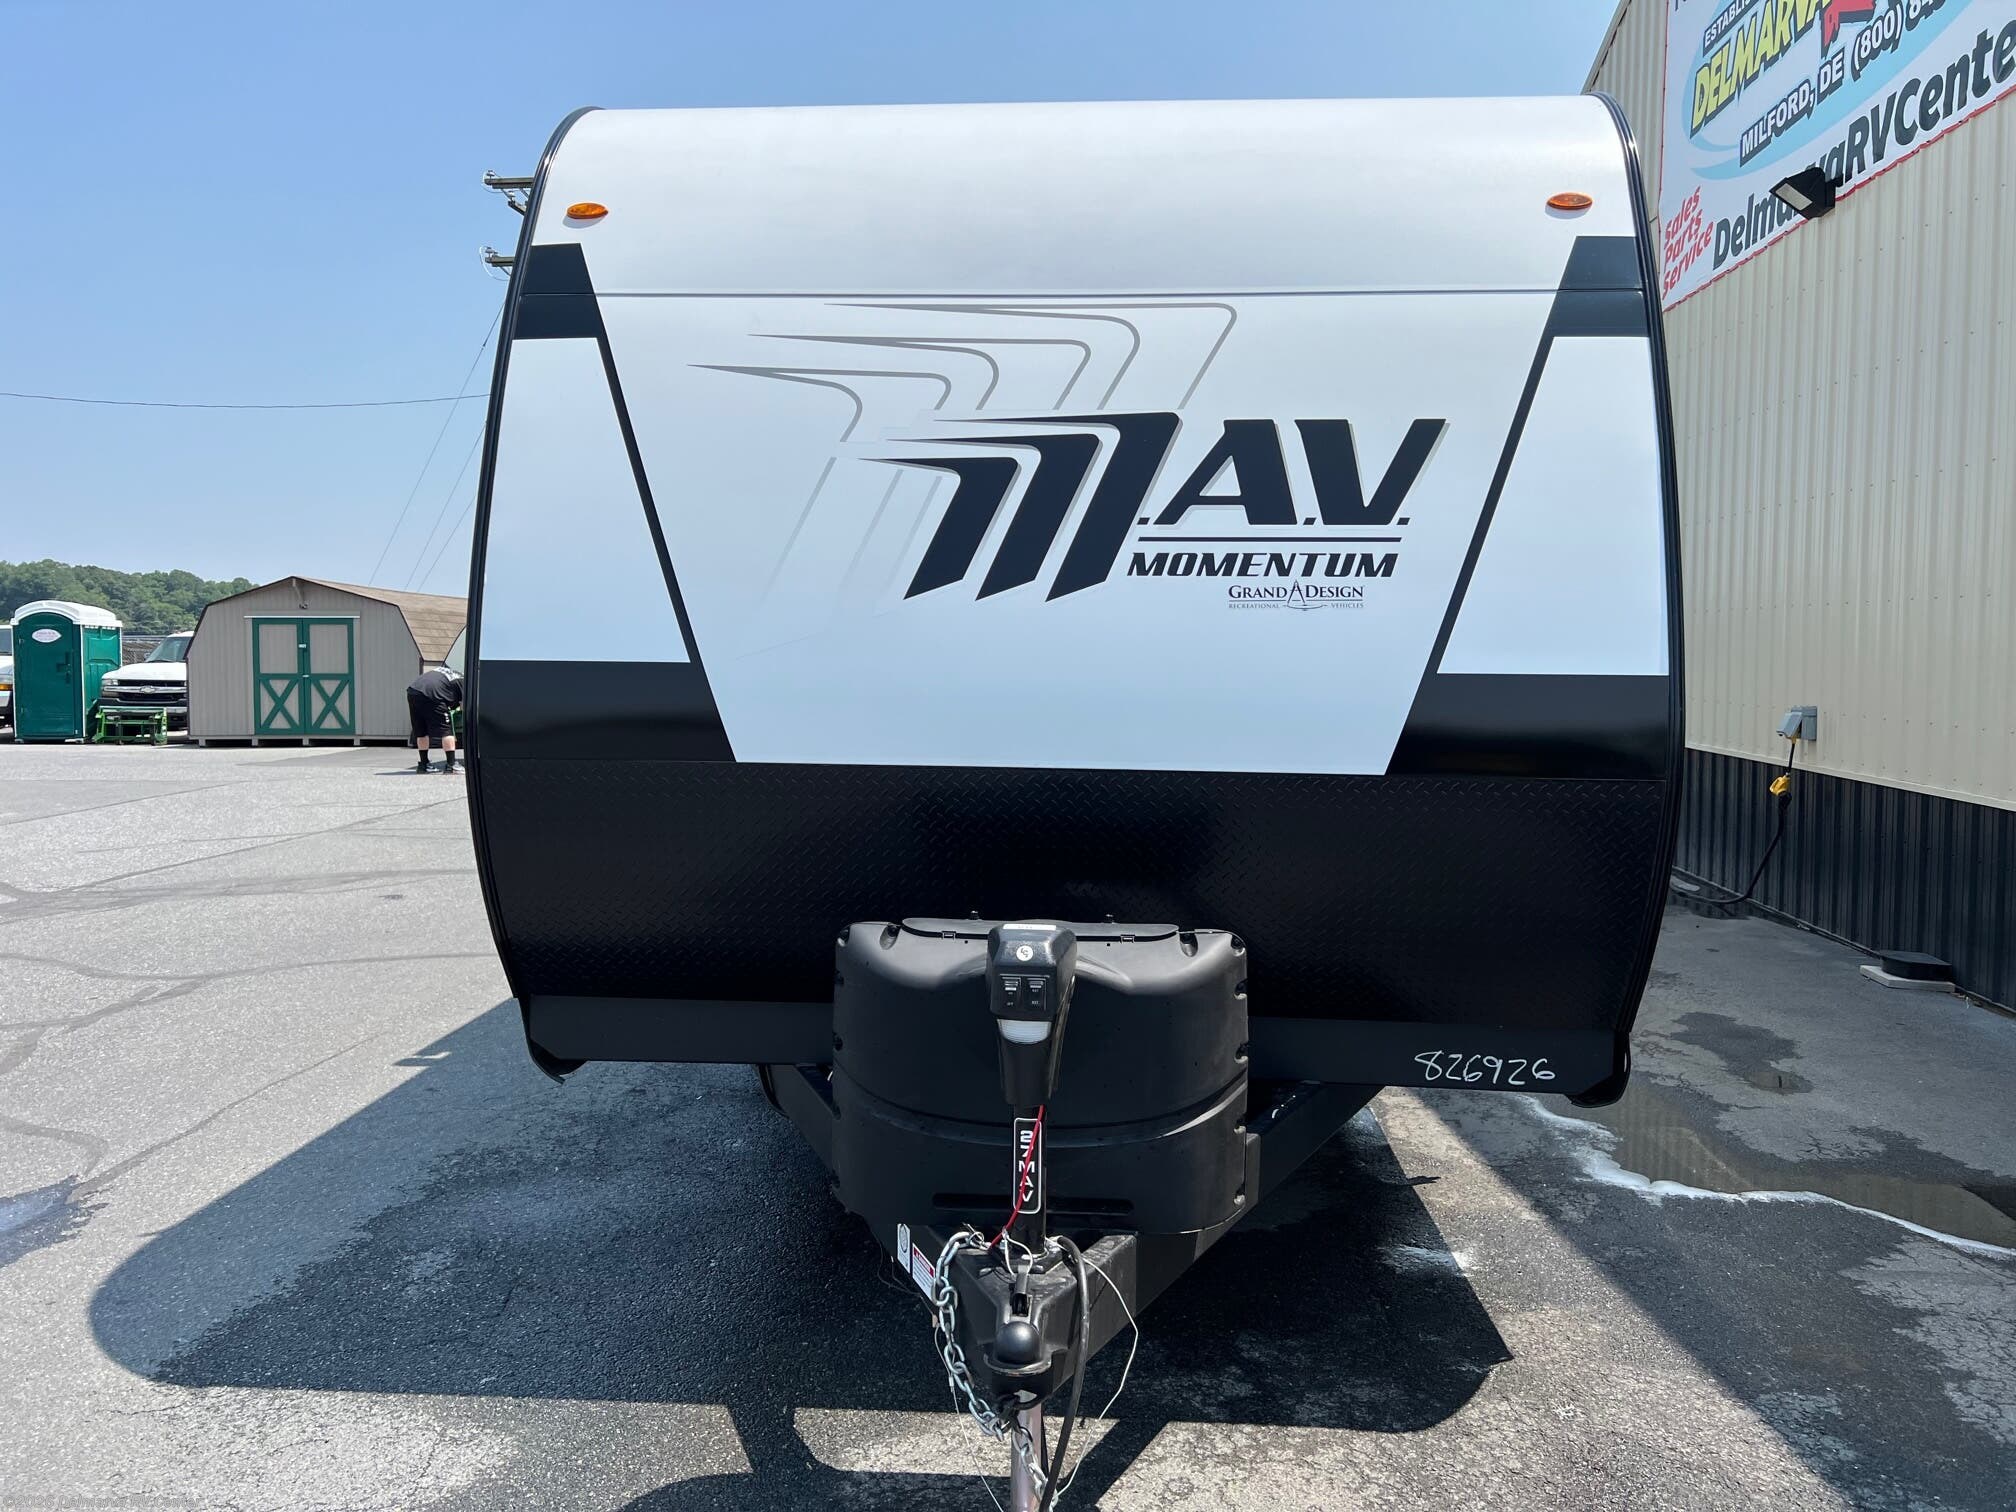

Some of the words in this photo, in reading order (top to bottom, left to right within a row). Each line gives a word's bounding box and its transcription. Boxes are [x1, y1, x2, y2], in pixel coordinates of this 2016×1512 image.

[1740, 80, 1815, 162] MILFORD,
[1818, 51, 1844, 98] DE
[1852, 3, 1903, 77] (800)
[1127, 552, 1398, 577] MOMENTUM
[1228, 585, 1288, 598] GRAND
[1304, 585, 1364, 598] DESIGN
[1414, 1050, 1556, 1086] 826926
